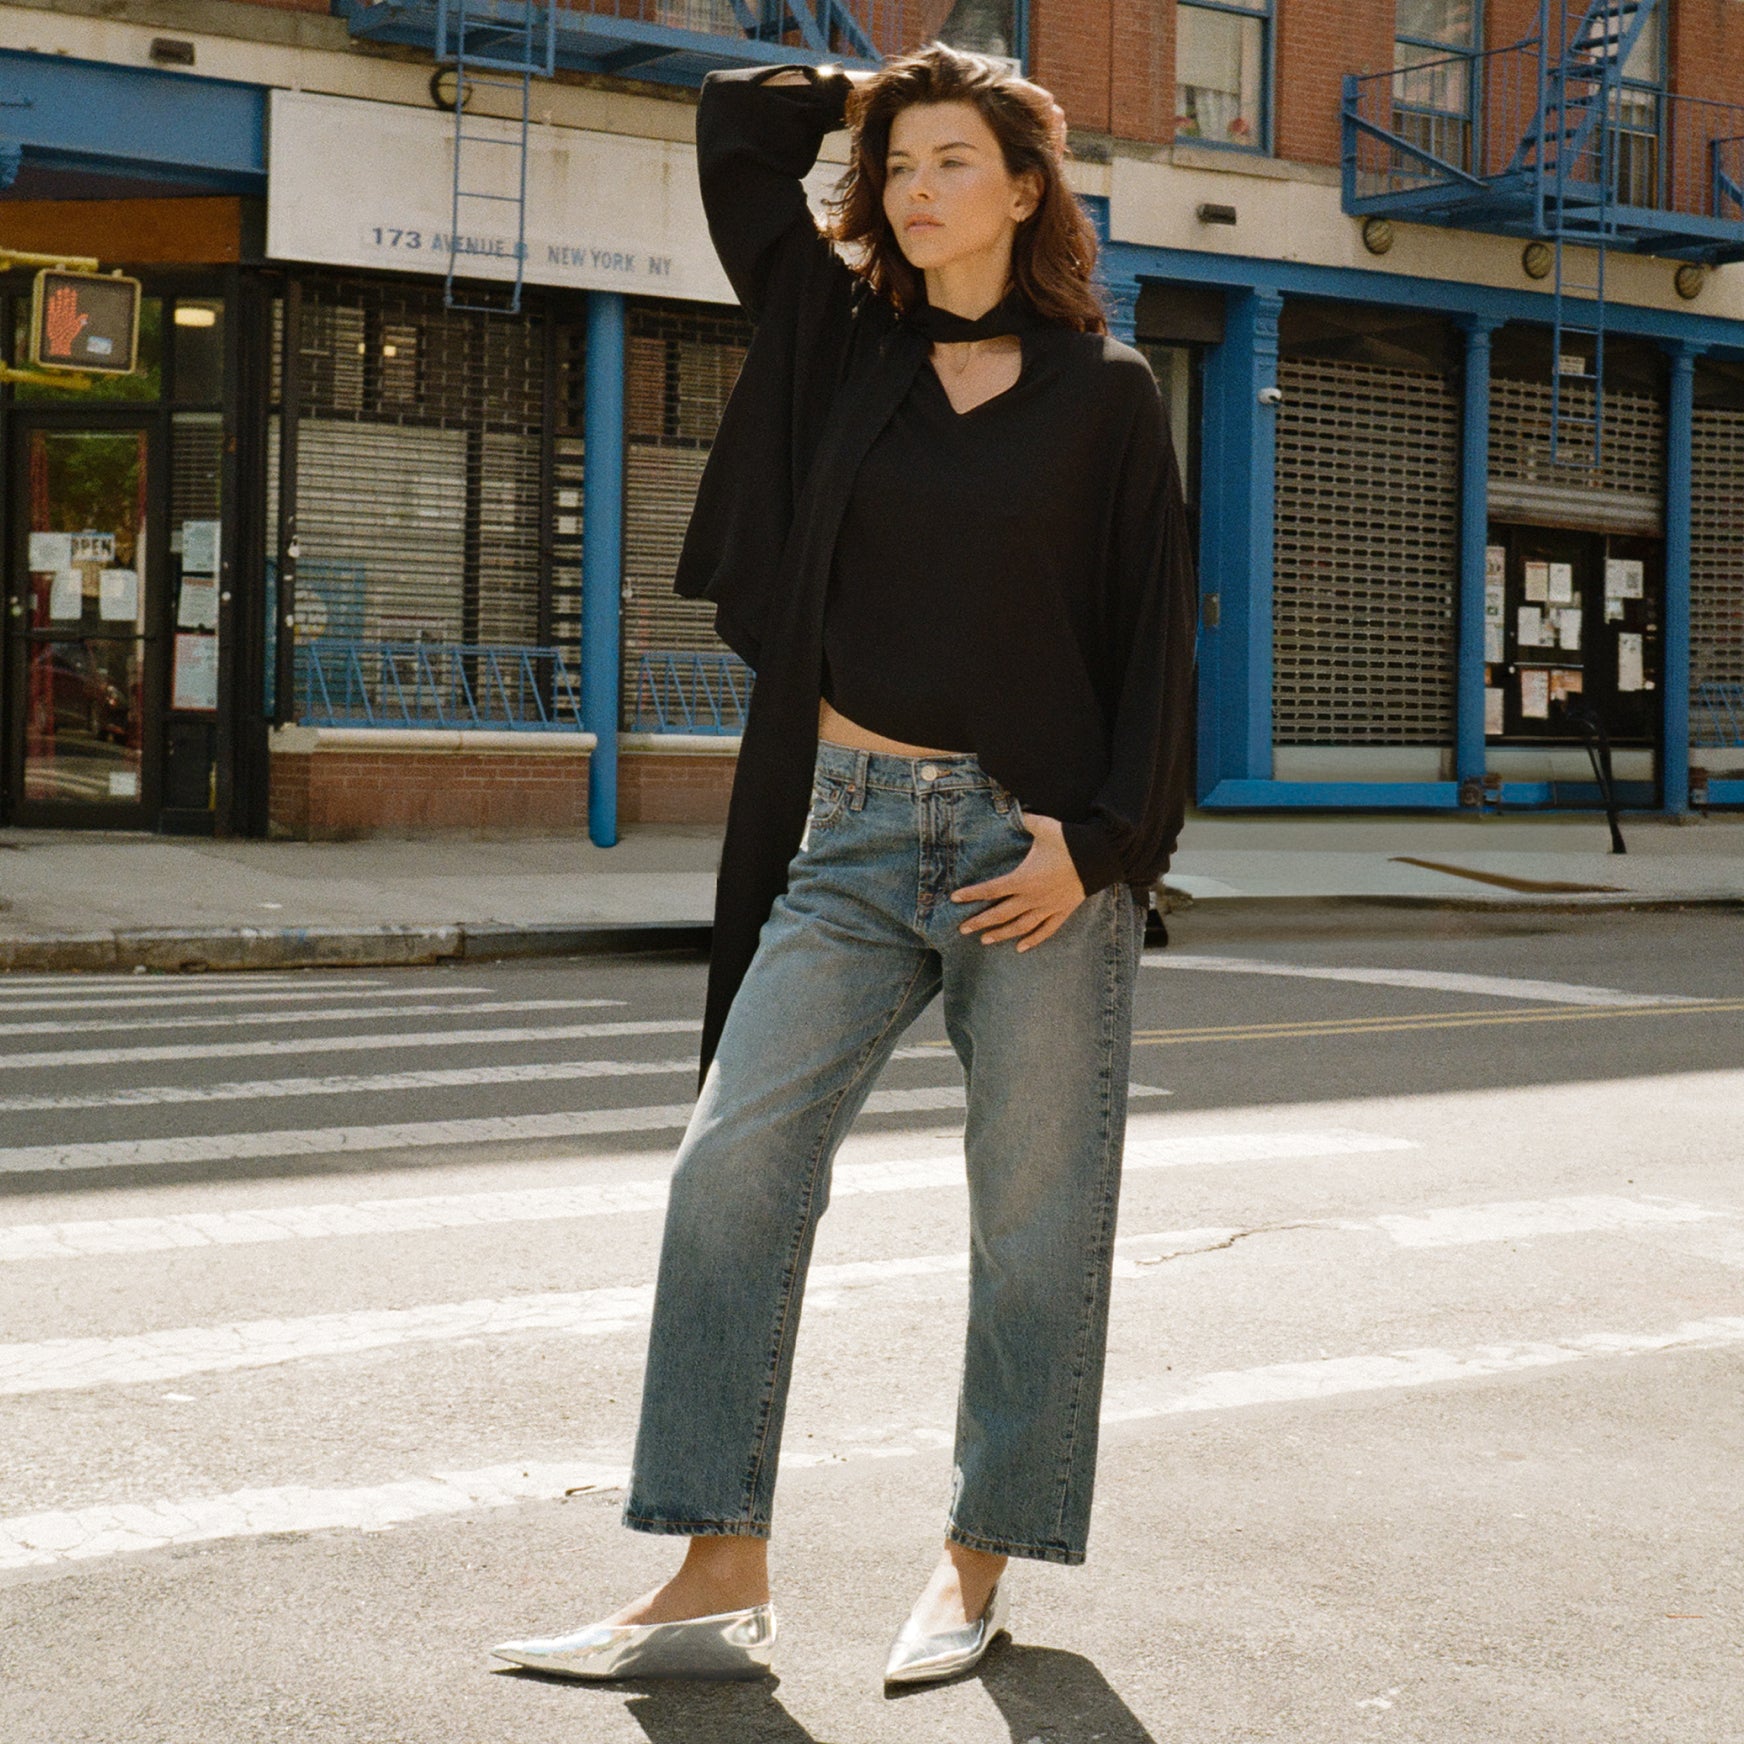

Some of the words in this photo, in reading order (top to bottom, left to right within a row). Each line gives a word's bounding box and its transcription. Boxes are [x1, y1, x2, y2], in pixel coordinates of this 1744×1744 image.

[372, 227, 422, 249] 173
[547, 245, 585, 267] NEW
[590, 247, 636, 273] YORK
[648, 256, 672, 276] NY
